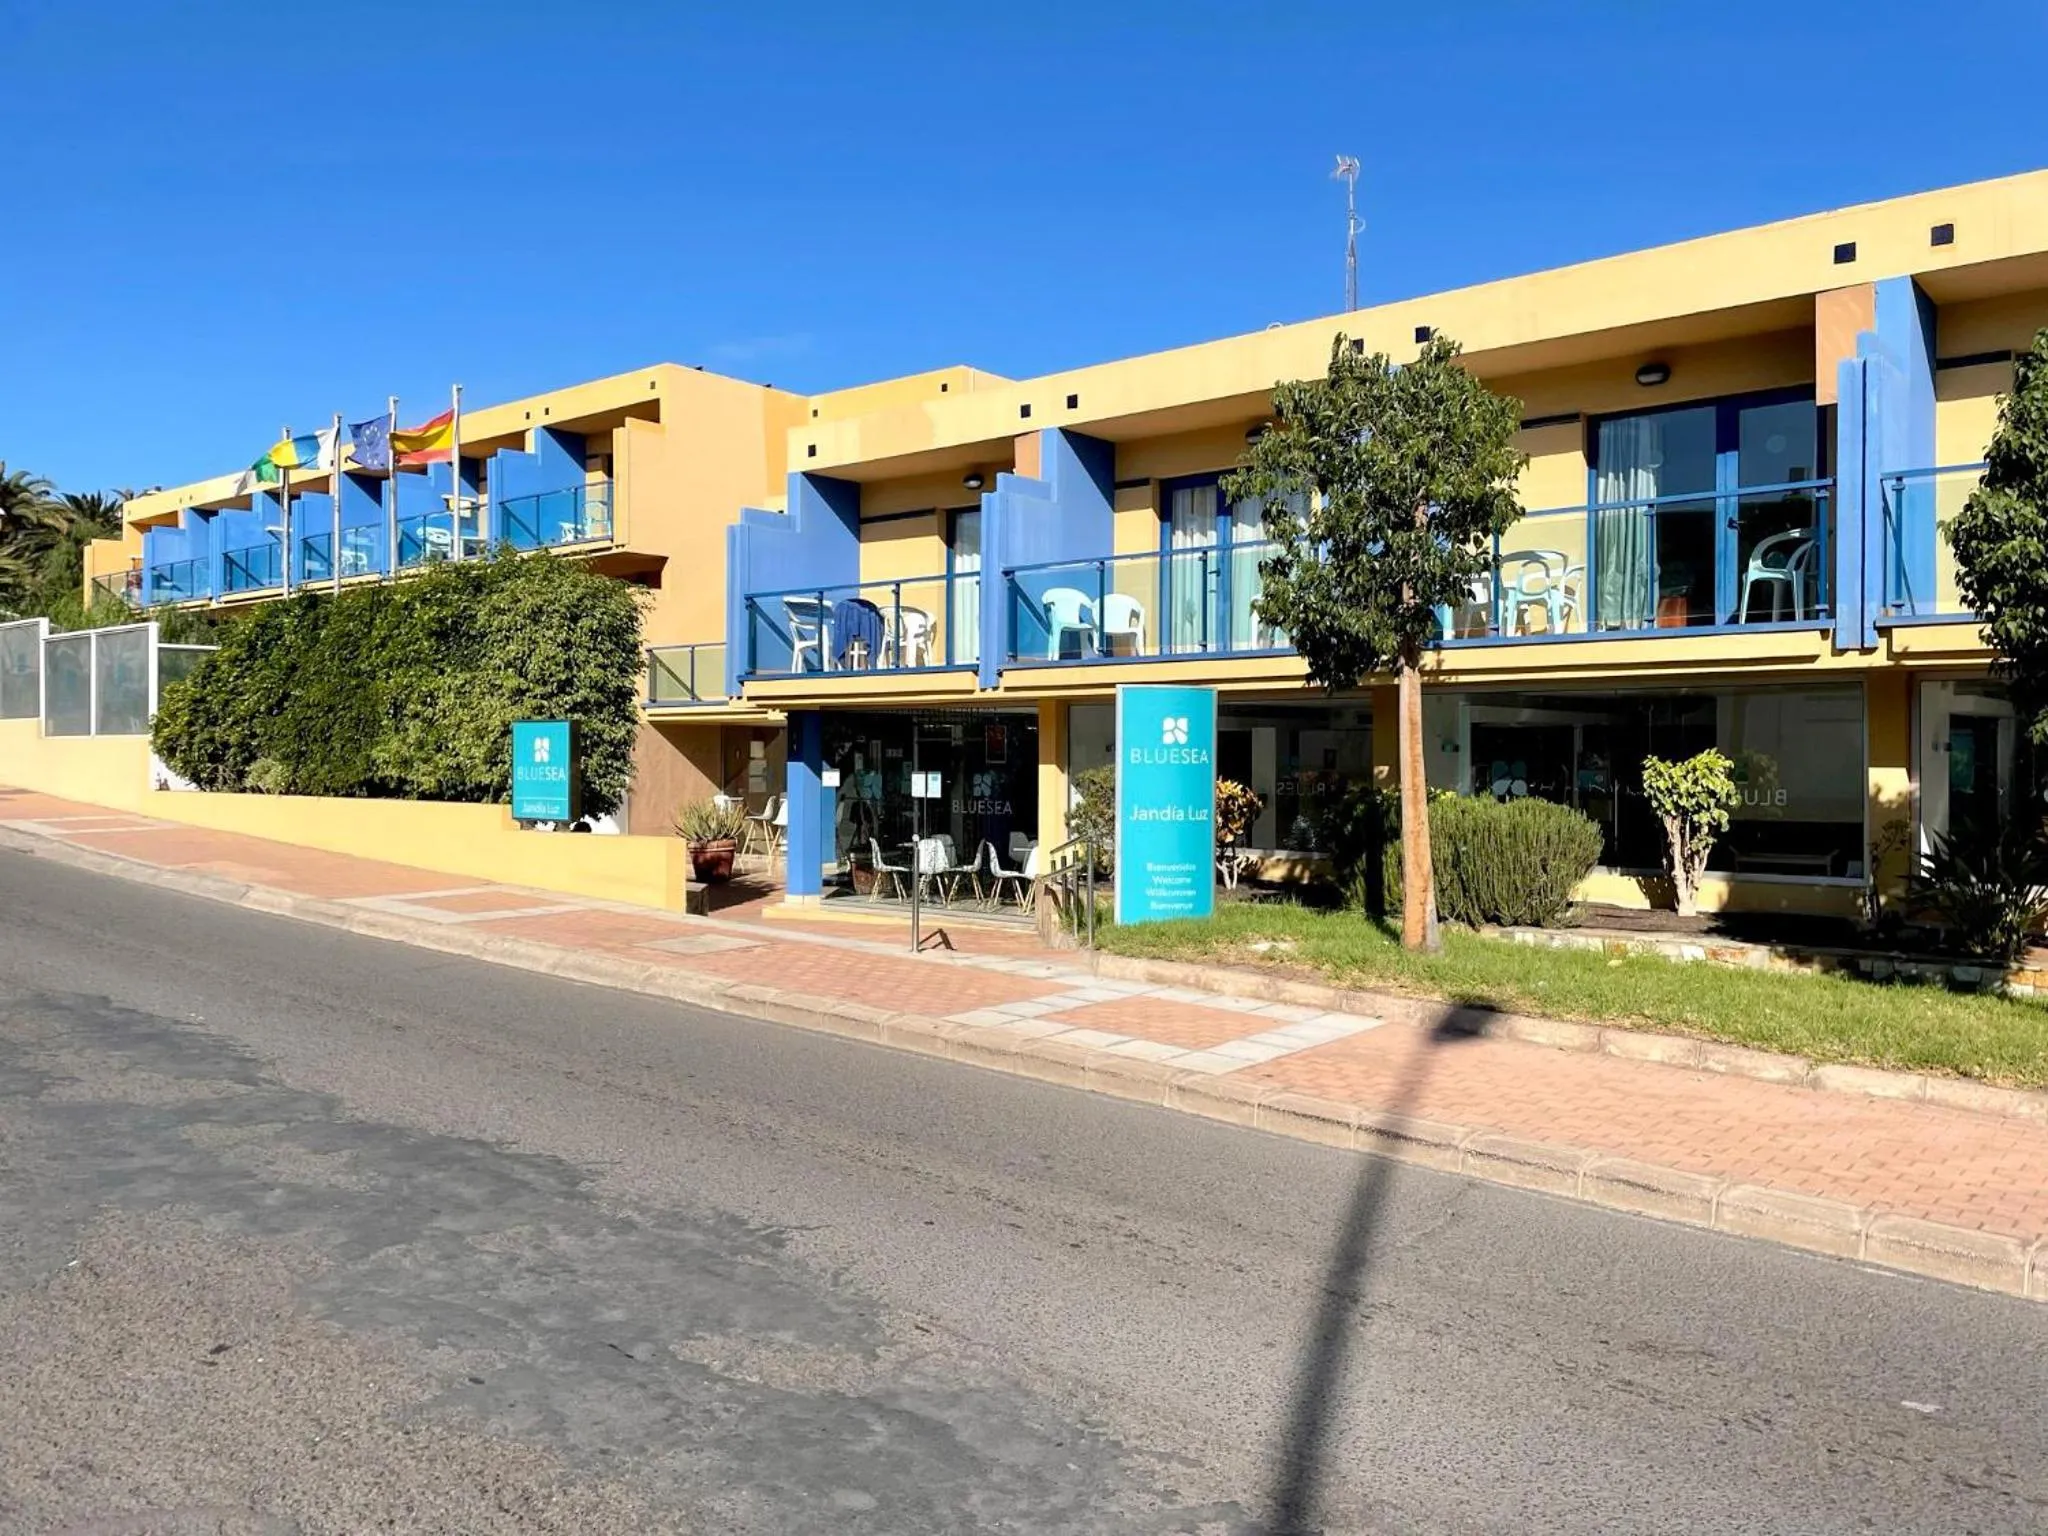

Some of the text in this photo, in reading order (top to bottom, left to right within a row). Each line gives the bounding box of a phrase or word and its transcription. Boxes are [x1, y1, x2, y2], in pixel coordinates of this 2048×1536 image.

[1130, 747, 1209, 764] BLUESEA
[516, 766, 566, 781] BLUESEA
[951, 799, 1013, 815] BLUESEA
[1129, 804, 1209, 821] Jandía Luz
